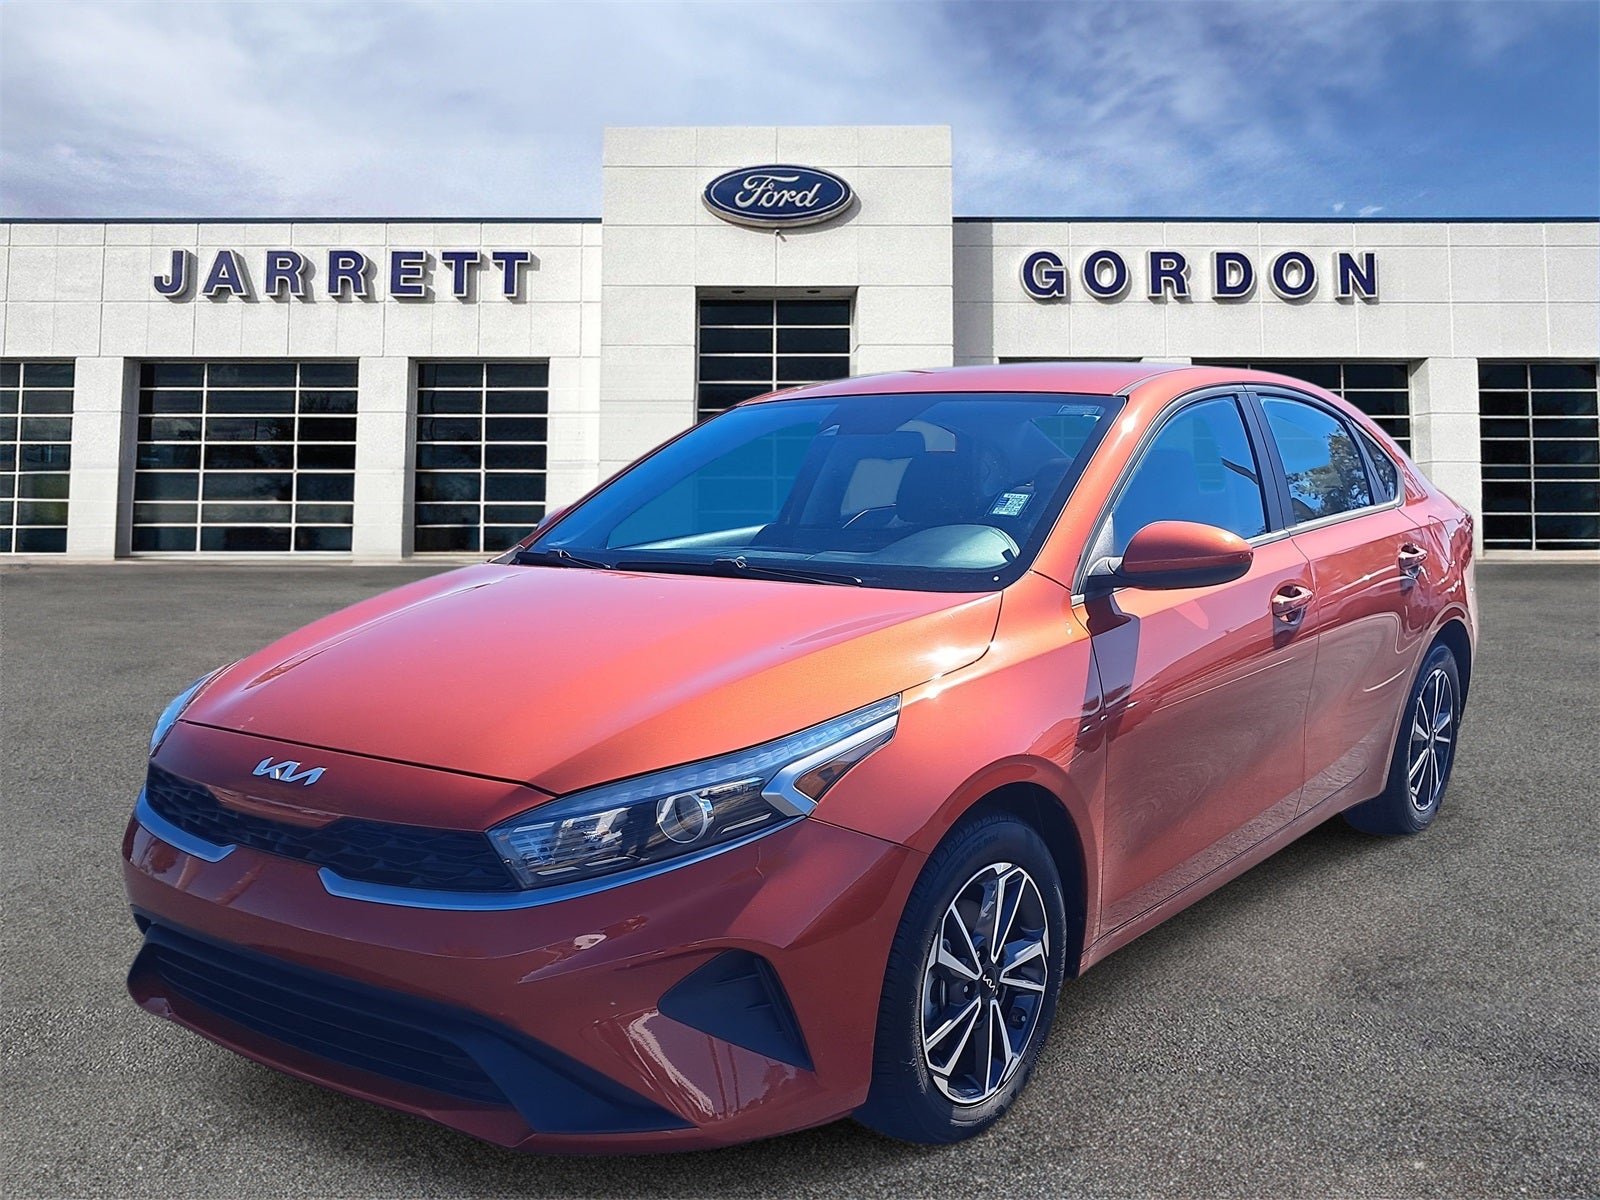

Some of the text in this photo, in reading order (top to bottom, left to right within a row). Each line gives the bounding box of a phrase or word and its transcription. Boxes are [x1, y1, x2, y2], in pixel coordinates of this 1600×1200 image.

[735, 174, 822, 208] Ford
[153, 248, 531, 298] JARRETT
[1021, 250, 1379, 299] GORDON
[252, 756, 328, 786] KIA
